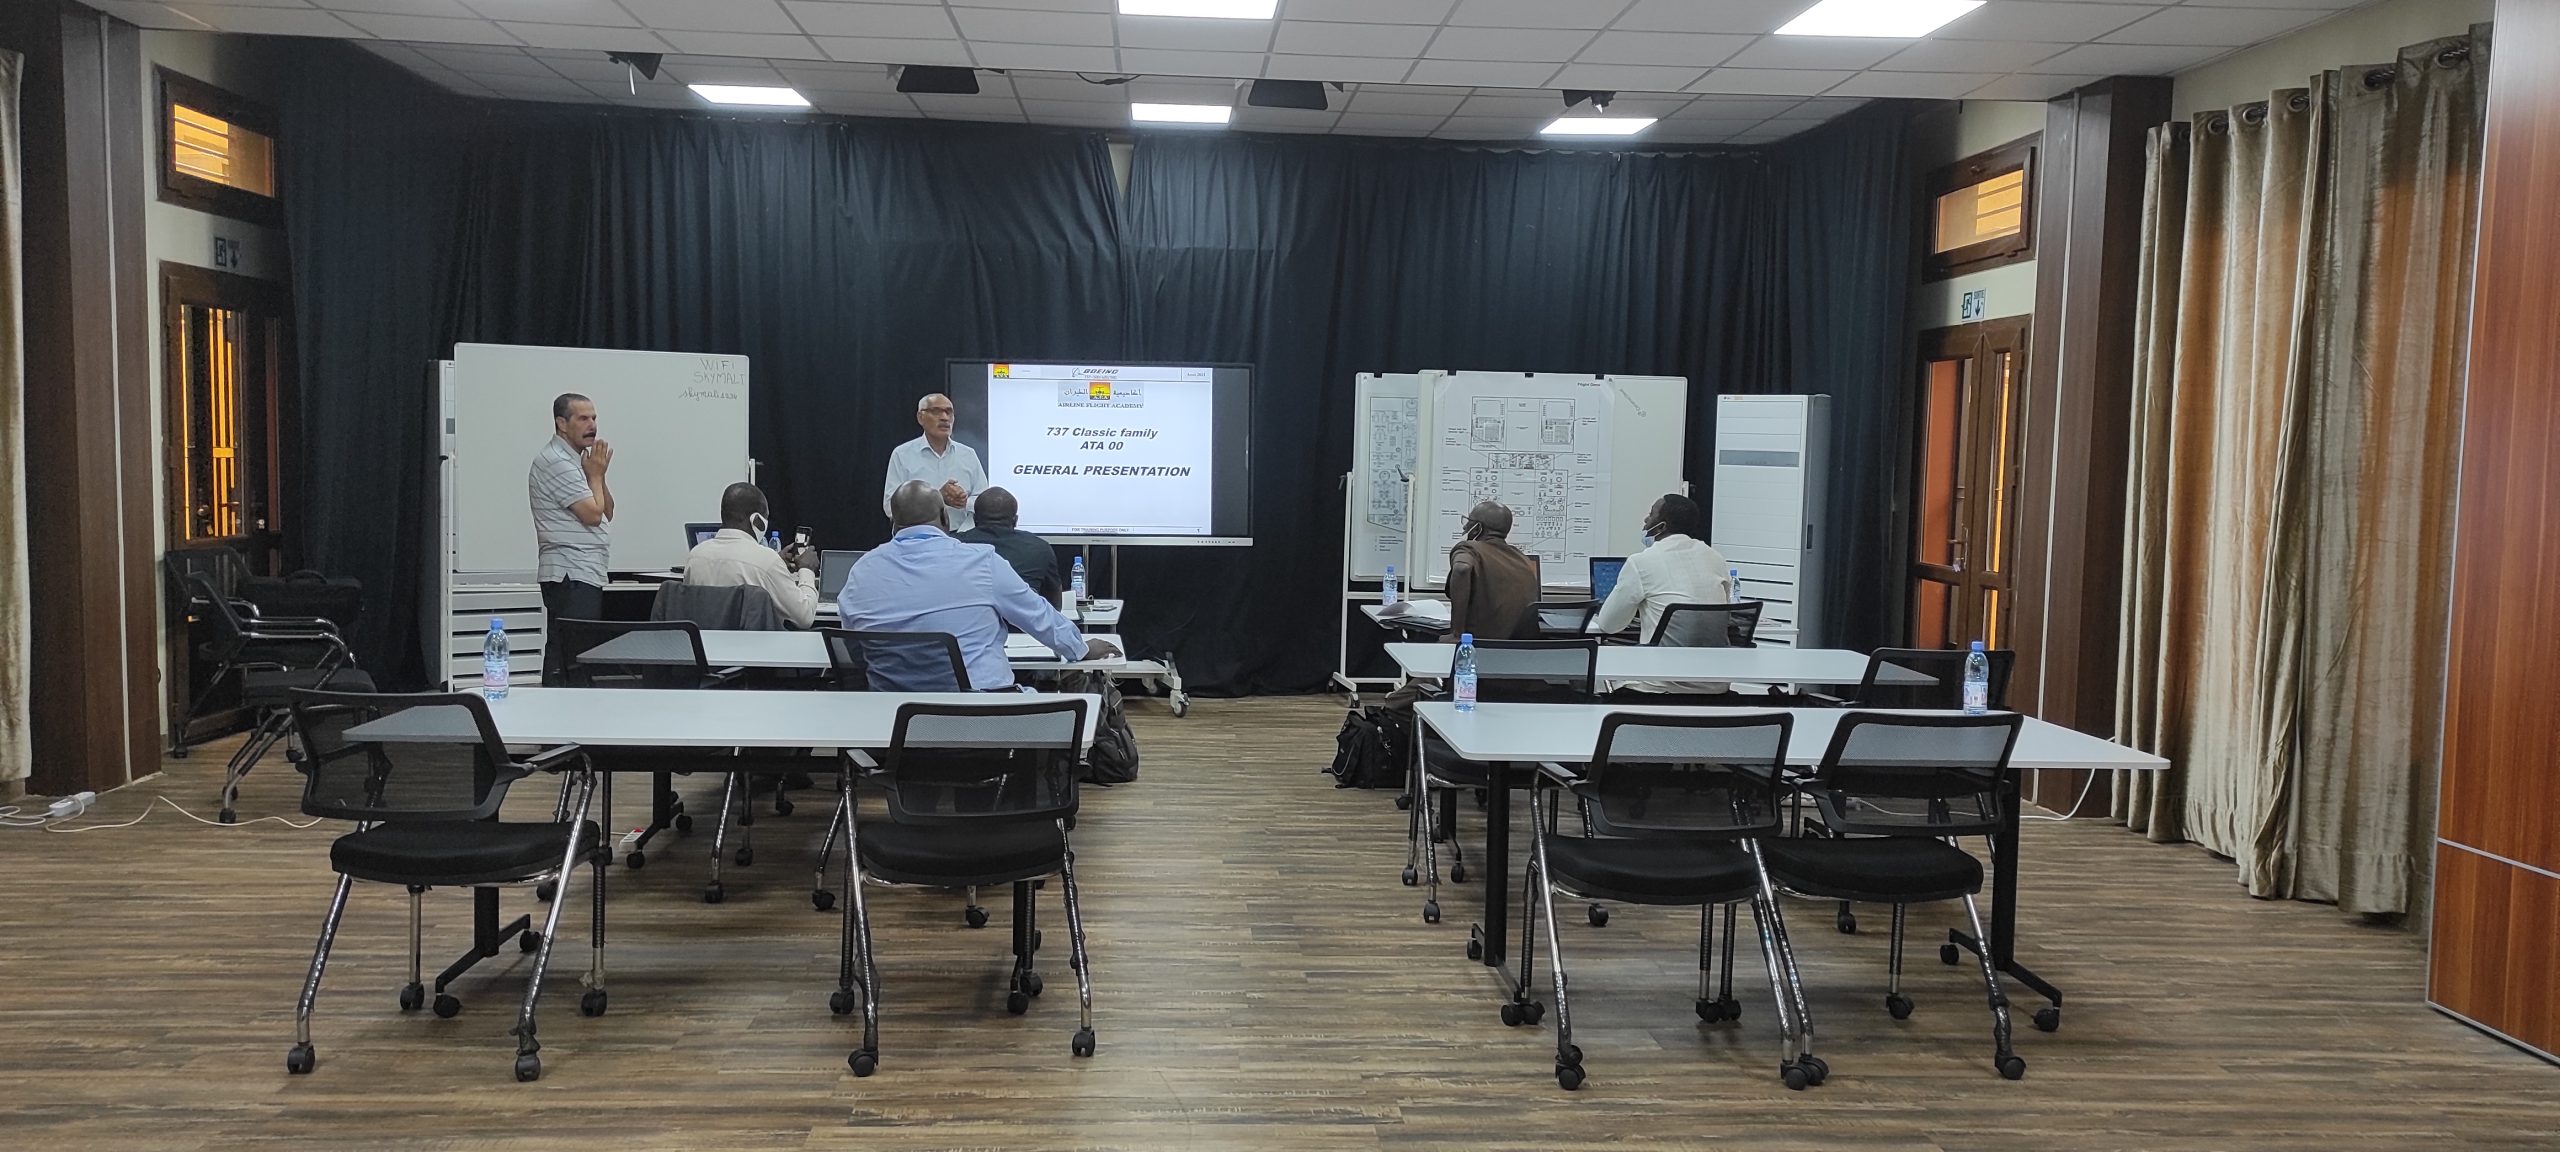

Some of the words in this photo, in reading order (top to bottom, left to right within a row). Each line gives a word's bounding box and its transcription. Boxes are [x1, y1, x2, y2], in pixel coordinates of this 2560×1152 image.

[1046, 427, 1069, 436] 737
[1072, 427, 1117, 437] Classic
[1120, 428, 1159, 440] family
[1080, 441, 1105, 450] ATA
[1108, 441, 1124, 450] 00
[1013, 465, 1079, 476] GENERAL
[1083, 465, 1191, 477] PRESENTATION
